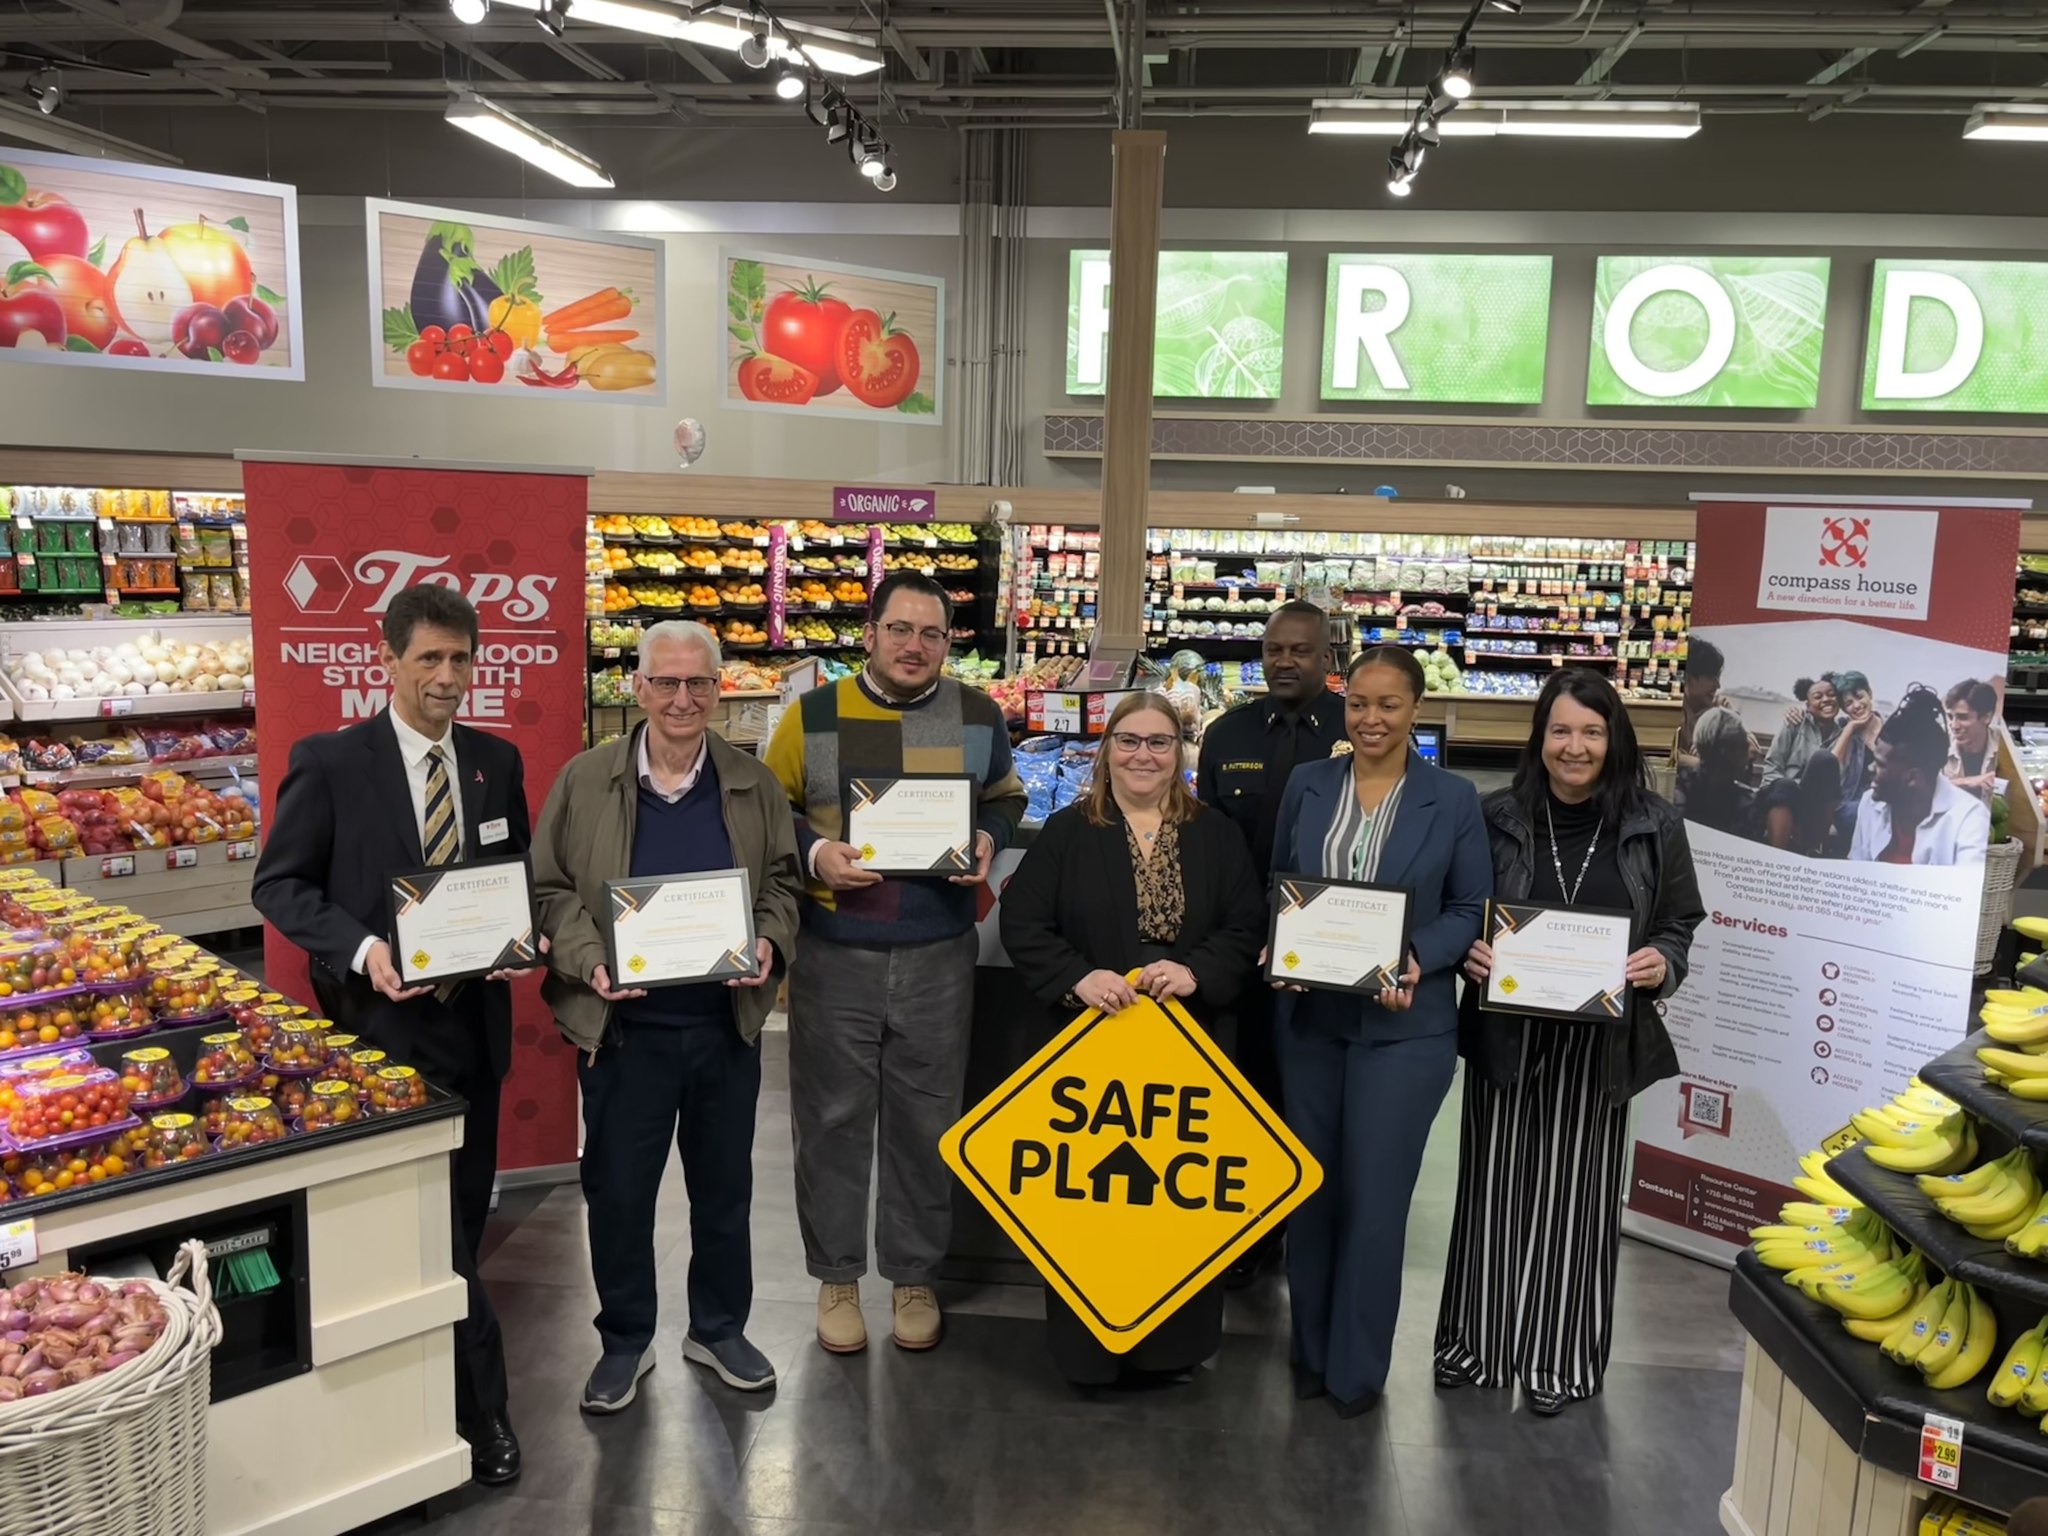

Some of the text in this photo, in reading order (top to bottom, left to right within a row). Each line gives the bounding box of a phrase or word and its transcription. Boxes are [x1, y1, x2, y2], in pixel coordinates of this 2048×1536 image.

[1332, 264, 1411, 390] R
[1603, 264, 1736, 398] O
[1874, 270, 1984, 400] D
[847, 493, 900, 513] ORGANIC
[772, 545, 786, 603] ORGANIC
[871, 546, 883, 592] ORGAN
[1768, 573, 1918, 595] compass house
[1766, 591, 1774, 601] A
[1776, 594, 1795, 602] new
[1797, 593, 1842, 605] direction
[1844, 595, 1858, 606] for
[1868, 598, 1897, 609] better
[1899, 600, 1918, 610] life.
[897, 790, 955, 799] CERTIFICATE
[446, 876, 510, 892] CERTIFICATE
[1712, 851, 1735, 862] House
[1737, 856, 1763, 867] stands
[1776, 863, 1791, 871] one
[1804, 867, 1818, 876] the
[1880, 881, 1909, 893] shelter
[1910, 888, 1927, 897] and
[1928, 892, 1962, 903] service
[1718, 861, 1730, 869] for
[1757, 869, 1791, 881] offering
[1871, 890, 1887, 898] and
[1888, 893, 1898, 901] so
[1899, 895, 1923, 906] much
[663, 890, 726, 903] CERTIFICATE
[1714, 869, 1734, 879] From
[1742, 876, 1765, 885] warm
[1766, 879, 1782, 888] bed
[1783, 883, 1799, 891] and
[1800, 885, 1814, 894] hot
[1816, 889, 1840, 898] meals
[1853, 896, 1879, 908] caring
[1725, 880, 1764, 894] Compass
[1765, 888, 1791, 899] House
[1800, 894, 1820, 904] here
[1821, 899, 1843, 908] when
[1844, 903, 1859, 912] you
[1860, 906, 1881, 916] need
[1327, 898, 1388, 911] CERTIFICATE
[1797, 904, 1813, 912] and
[1815, 905, 1832, 916] 365
[1832, 910, 1853, 921] days
[1546, 922, 1612, 936] CERTIFICATE
[1711, 910, 1788, 938] Services
[1049, 1076, 1211, 1143] SAFE
[1638, 1179, 1685, 1201] Contact us
[1700, 1173, 1758, 1196] Resource Center
